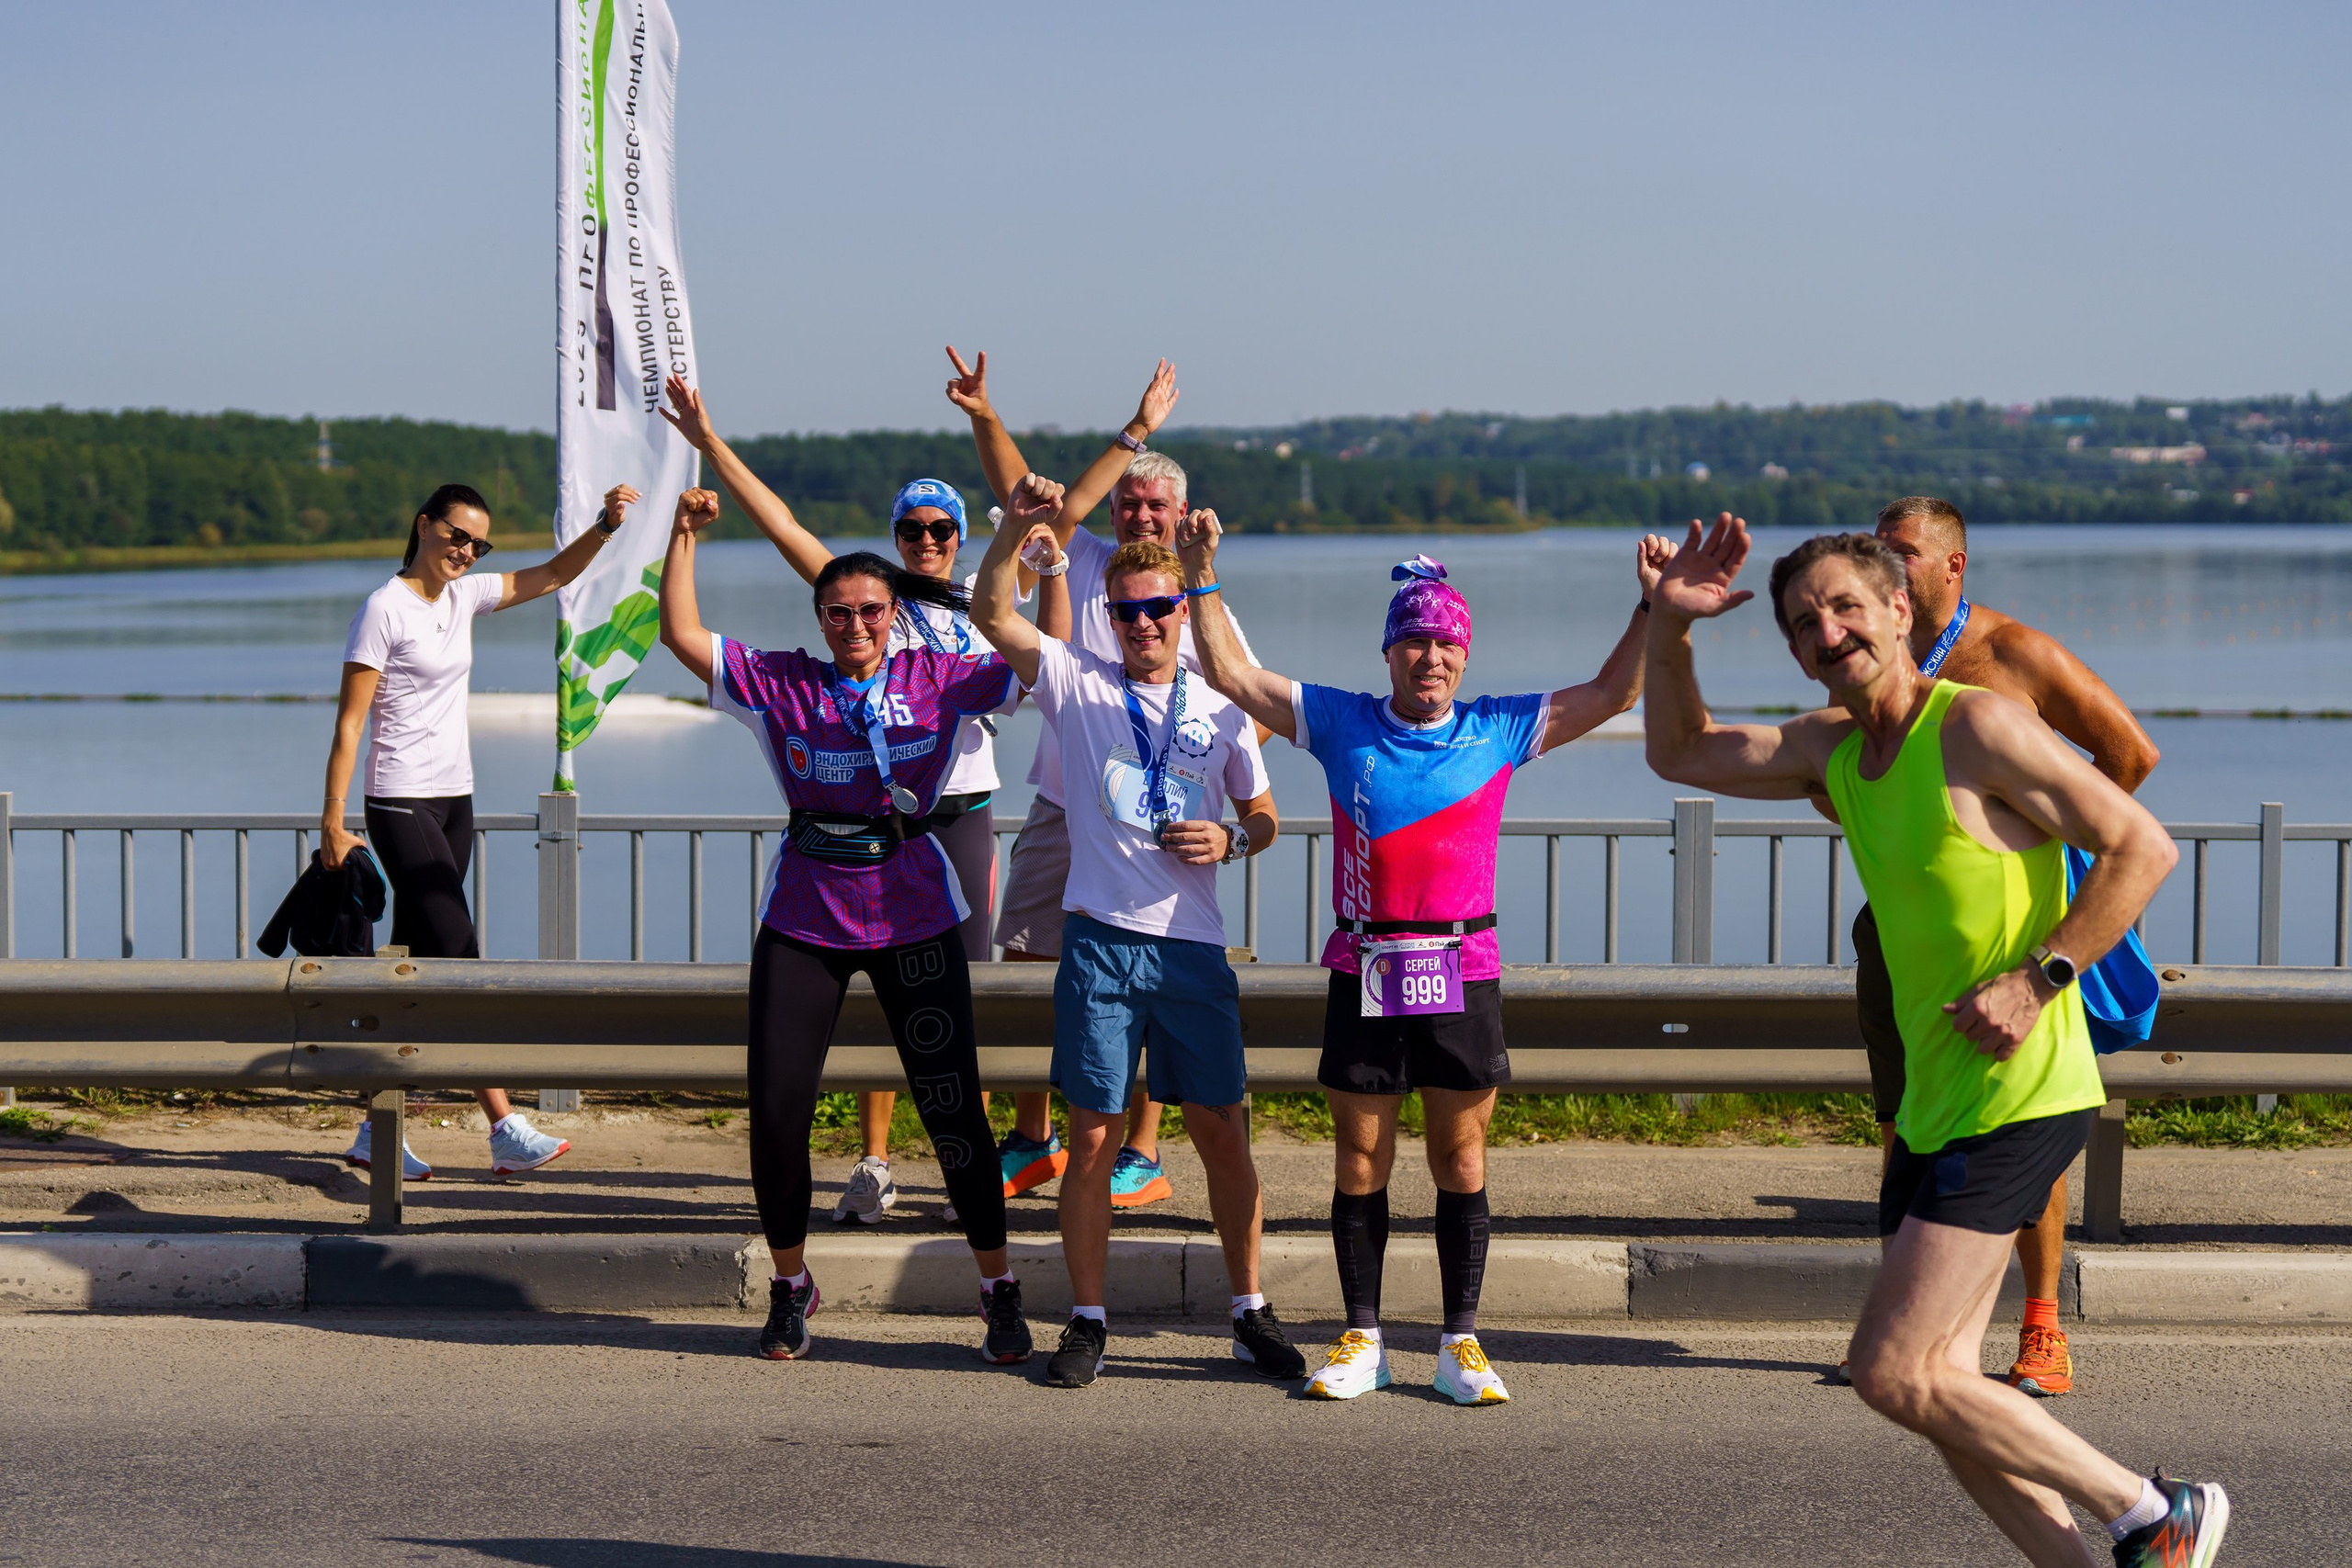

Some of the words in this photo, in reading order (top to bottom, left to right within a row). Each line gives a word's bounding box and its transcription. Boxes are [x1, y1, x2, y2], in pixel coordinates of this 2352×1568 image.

[628, 236, 643, 267] ПО
[657, 265, 688, 381] СТЕРСТВУ
[630, 275, 659, 412] ЧЕМПИОНАТ
[816, 736, 936, 767] ЭНДОХИРУИЧЕСКИЙ
[1470, 738, 1490, 747] СПОРТ
[816, 767, 854, 783] ЦЕНТР
[1157, 766, 1166, 798] СПОРТ
[1136, 791, 1181, 823] 93
[1405, 956, 1441, 972] СЕРГЕЙ
[1402, 975, 1447, 1006] 999
[897, 941, 972, 1170] BORG
